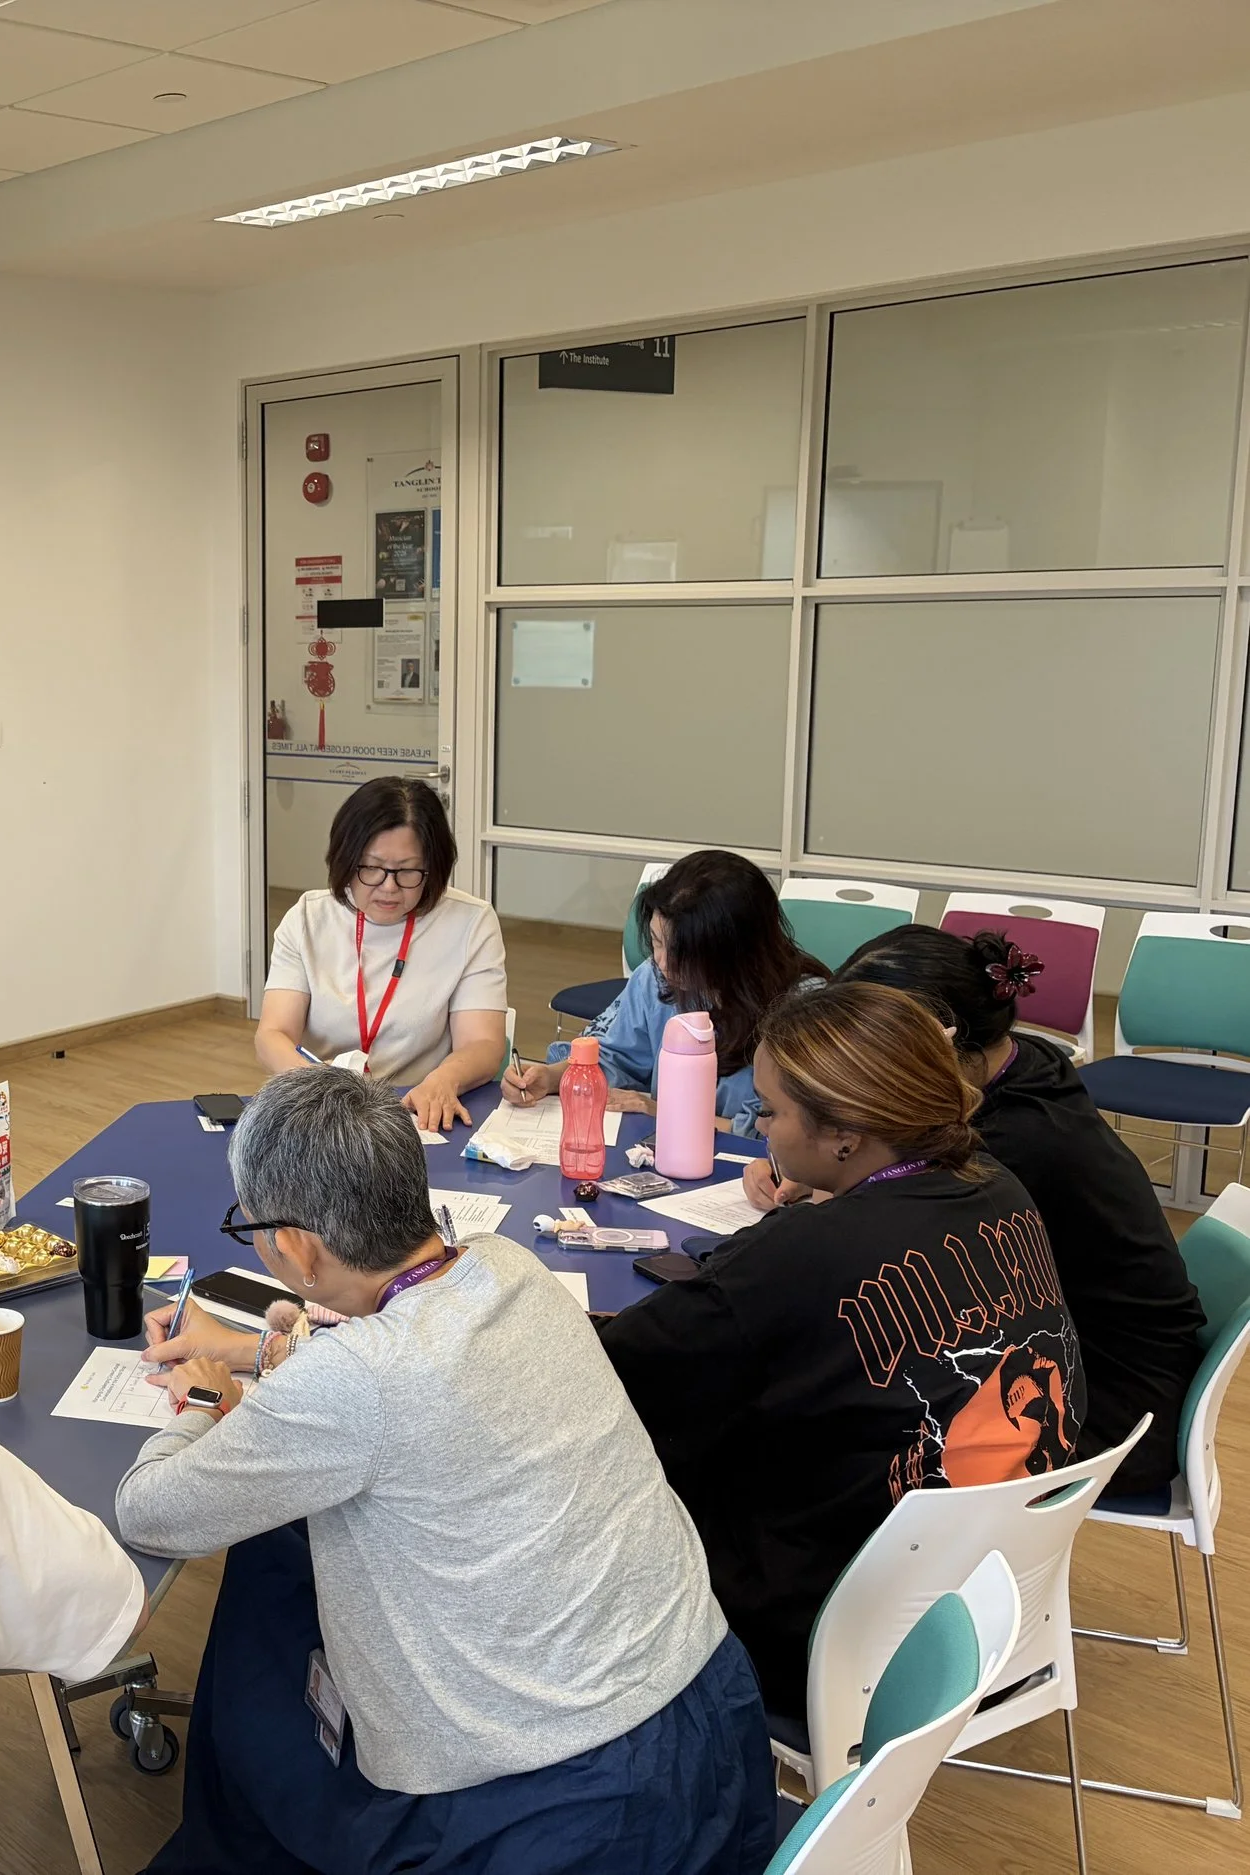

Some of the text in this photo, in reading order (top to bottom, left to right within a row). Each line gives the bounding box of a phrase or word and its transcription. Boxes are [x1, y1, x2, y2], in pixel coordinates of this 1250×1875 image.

[653, 337, 670, 358] 11
[569, 352, 610, 366] The Institute
[393, 478, 434, 488] TANGLIN
[882, 1163, 916, 1178] TANGLIN
[406, 1260, 439, 1282] TANGLIN
